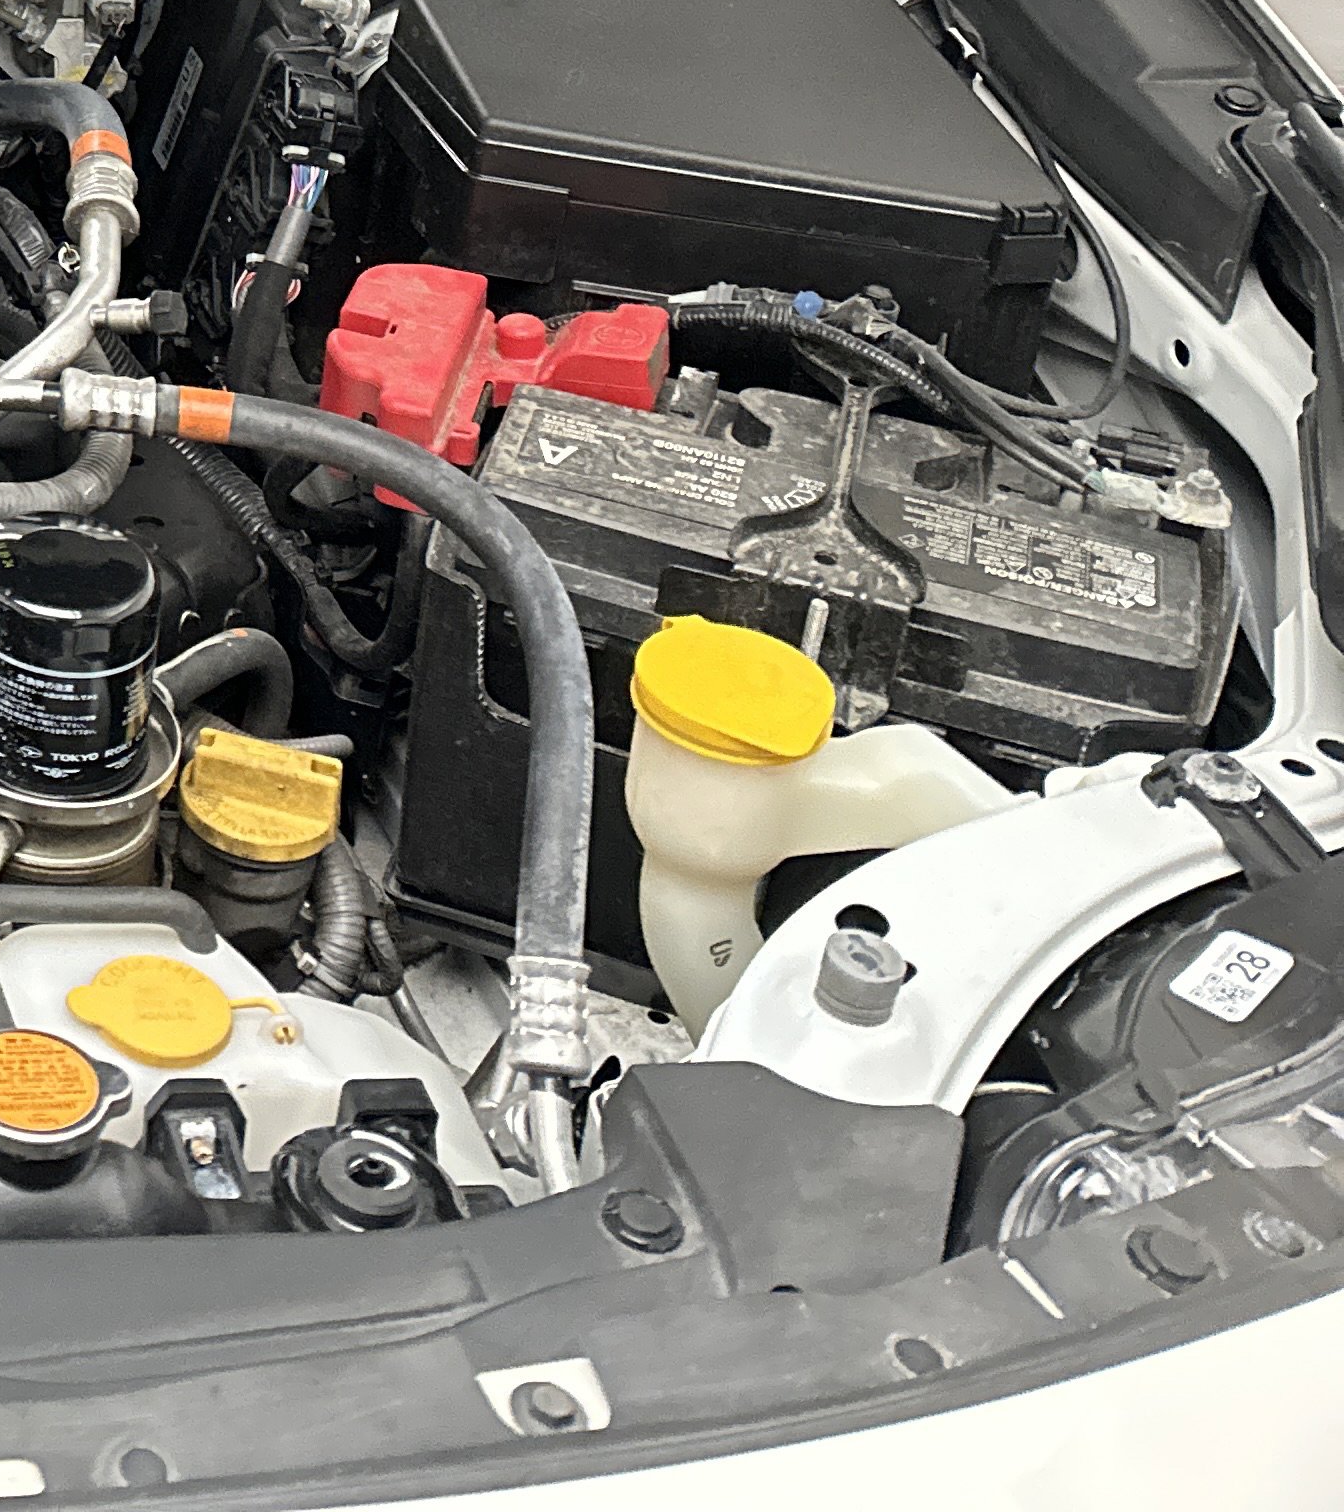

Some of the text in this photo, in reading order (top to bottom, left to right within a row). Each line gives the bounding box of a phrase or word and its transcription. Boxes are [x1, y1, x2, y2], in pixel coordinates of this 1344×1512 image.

[538, 437, 579, 465] A
[49, 751, 100, 763] TOKYO
[1225, 950, 1271, 983] 28
